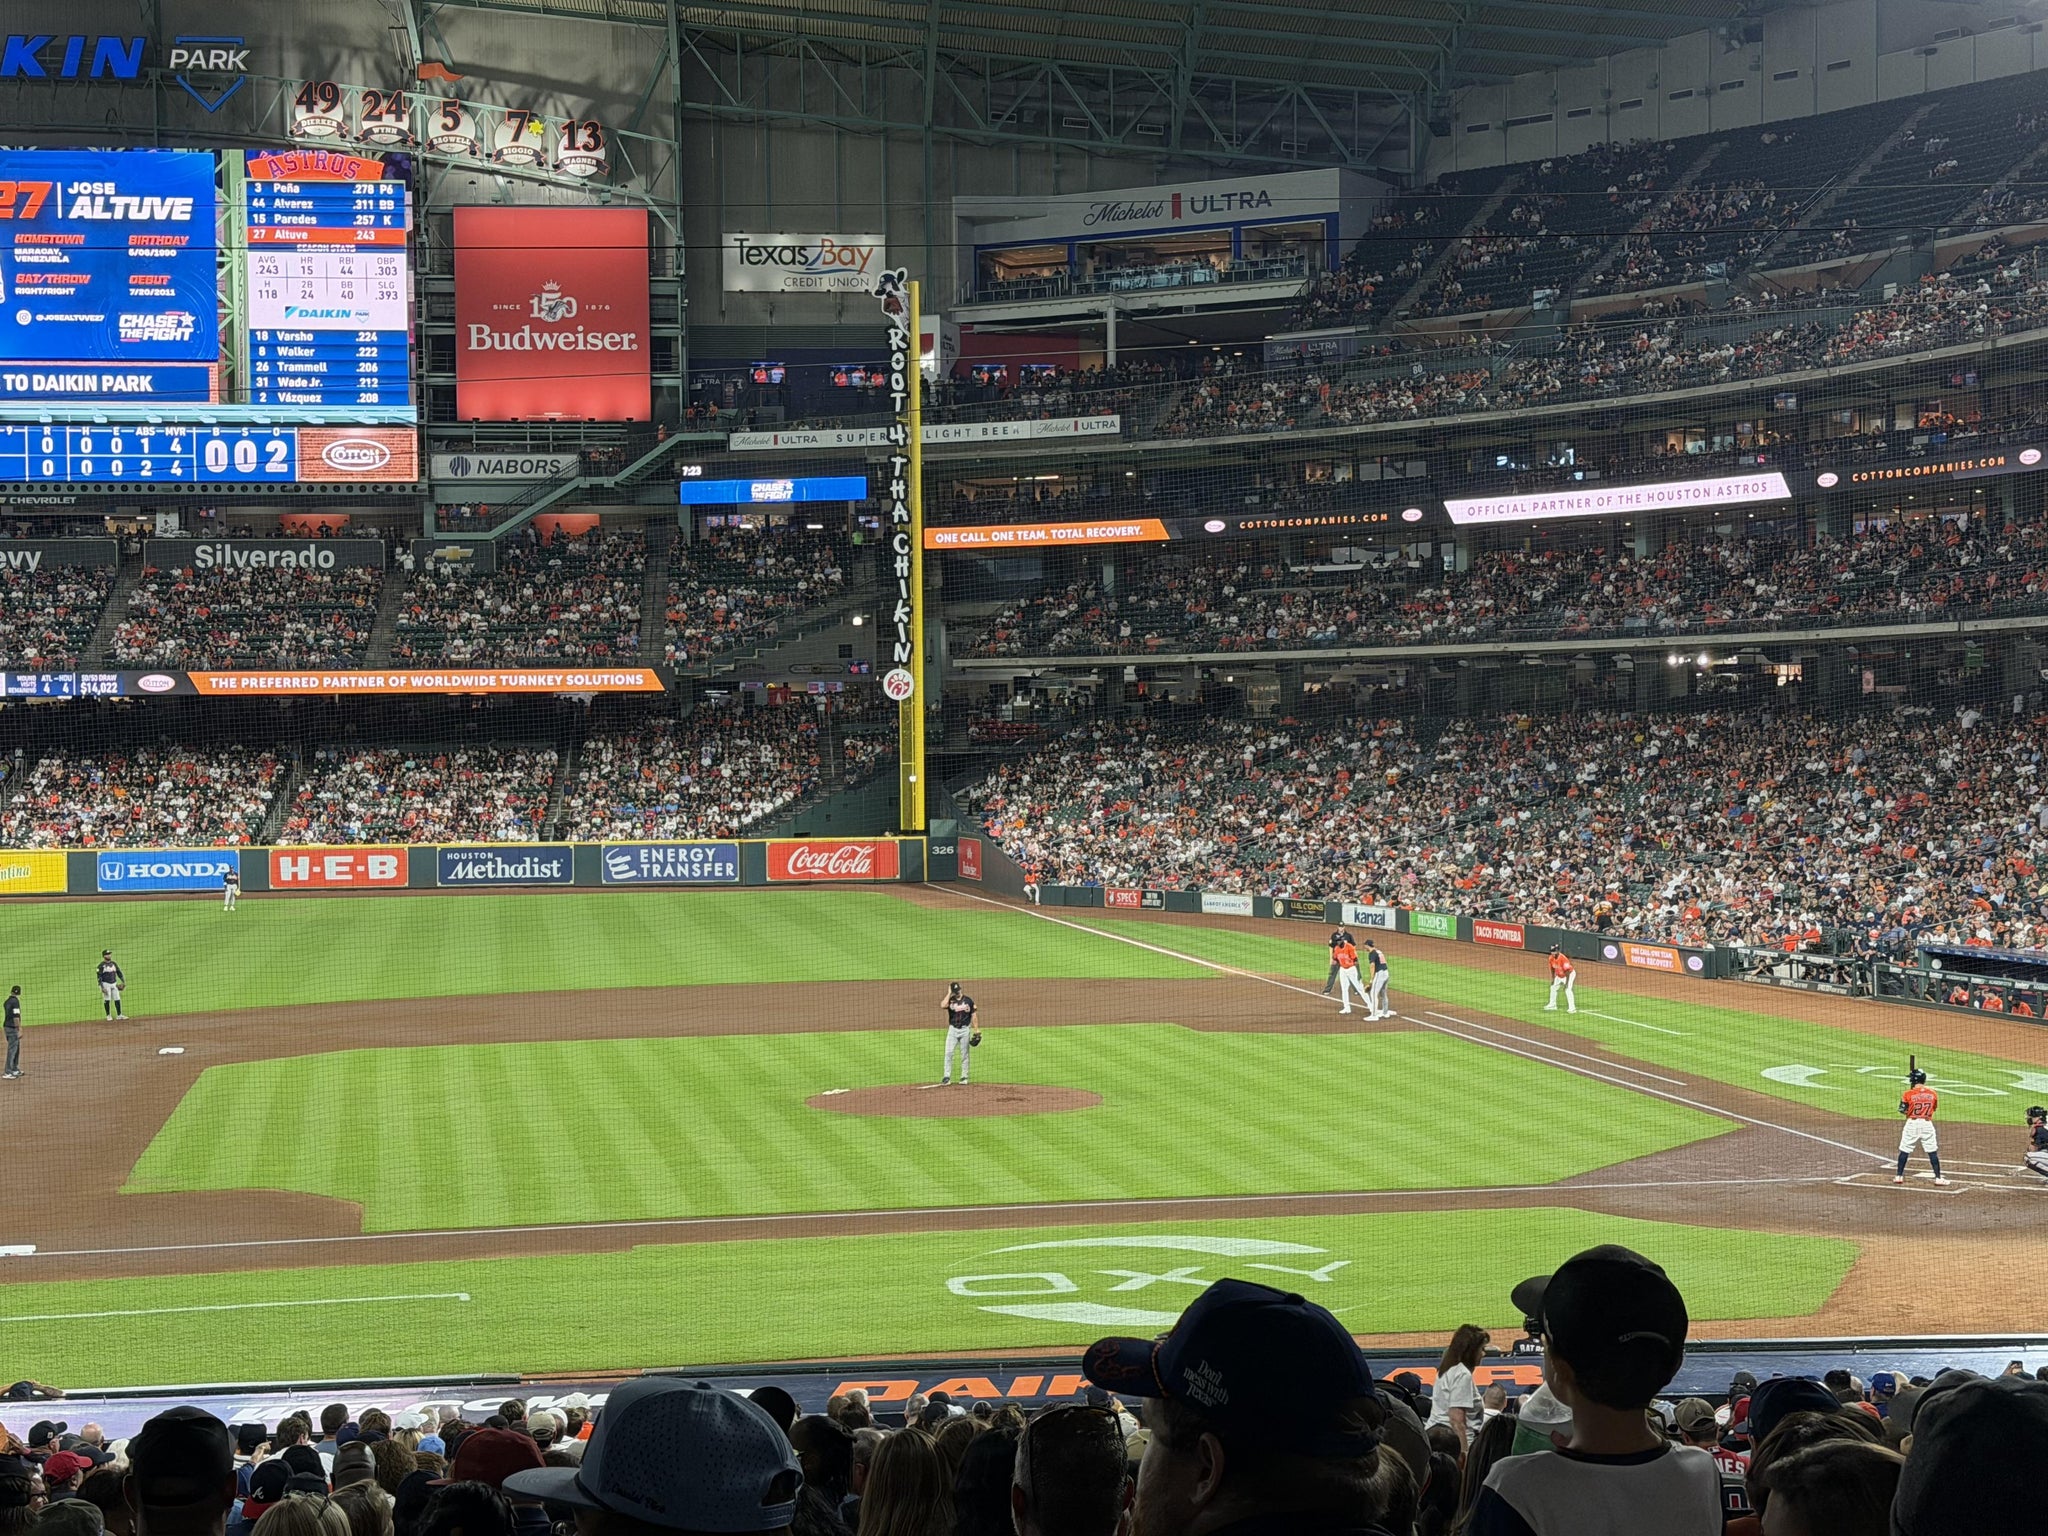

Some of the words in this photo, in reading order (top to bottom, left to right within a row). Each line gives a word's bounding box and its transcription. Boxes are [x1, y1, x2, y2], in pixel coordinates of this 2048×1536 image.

[1, 35, 146, 79] KIN
[169, 48, 251, 72] PARK
[295, 81, 342, 114] 49
[361, 90, 407, 123] 24
[441, 99, 462, 132] 5
[301, 118, 338, 128] DIERKER
[506, 110, 530, 143] 7
[372, 127, 398, 135] WYNN
[561, 119, 604, 152] 13
[432, 135, 472, 146] BAGWELL
[502, 147, 534, 156] BIGGIO
[267, 150, 361, 181] ASTROS
[563, 157, 597, 166] WAGNER
[67, 181, 115, 195] JOSE
[254, 184, 262, 193] 3
[273, 183, 300, 194] Peña
[352, 184, 374, 195] .278
[379, 185, 394, 195] P6
[68, 196, 194, 220] ALTUVE
[252, 199, 265, 208] 44
[273, 199, 314, 209] Alvarez
[352, 200, 374, 210] .311
[379, 200, 395, 210] BB
[1083, 199, 1165, 227] Michelob
[1190, 189, 1273, 215] ULTRA
[252, 214, 266, 224] 15
[274, 213, 317, 225] Paredes
[353, 215, 375, 226] .257
[383, 215, 392, 226] K
[14, 233, 85, 245] HOMETOWN
[128, 235, 189, 246] BIRTHDAY
[253, 230, 266, 240] 27
[274, 229, 308, 240] Altuve
[353, 230, 376, 241] .243
[14, 255, 70, 264] VENEZUELA
[258, 256, 276, 264] AVG
[339, 257, 354, 265] RBI
[377, 257, 395, 265] OBP
[734, 237, 809, 267] Texas
[820, 238, 873, 275] Bay
[255, 265, 279, 275] .243
[301, 266, 314, 275] 15
[340, 266, 354, 276] 44
[374, 266, 398, 276] .303
[15, 274, 91, 285] BAT/THROW
[129, 275, 171, 285] DEBUT
[341, 281, 353, 289] BB
[378, 281, 395, 290] SLG
[783, 277, 823, 288] CREDIT
[828, 277, 870, 288] UNION
[15, 287, 75, 296] RIGHT/RIGHT
[129, 288, 176, 297] 7/20/2011
[258, 289, 278, 299] 118
[301, 290, 314, 300] 24
[340, 290, 354, 300] 40
[375, 291, 399, 301] .393
[298, 309, 351, 319] DAIKIN
[530, 292, 577, 323] 150
[119, 314, 179, 328] CHASE
[119, 328, 144, 339] THE
[143, 328, 194, 341] FIGHT
[256, 331, 269, 341] 18
[277, 331, 314, 341] Varsho
[355, 332, 378, 342] .224
[258, 346, 266, 357] 8
[277, 346, 316, 357] Walker
[356, 347, 378, 357] .222
[256, 362, 269, 372] 26
[277, 362, 328, 372] Trammell
[356, 362, 378, 373] .206
[887, 328, 908, 413] ROOT
[3, 374, 29, 391] TO
[32, 374, 98, 392] DAIKIN
[102, 375, 153, 392] PARK
[256, 377, 269, 387] 31
[277, 377, 308, 388] Wade
[309, 377, 323, 388] Jr.
[356, 378, 379, 388] .212
[259, 392, 267, 403] 2
[277, 392, 322, 405] Vázquez
[356, 393, 379, 403] .208
[212, 427, 220, 436] B
[241, 427, 249, 436] S
[782, 435, 819, 444] ULTRA
[926, 427, 972, 438] LIGHT
[1081, 419, 1117, 431] ULTRA
[889, 423, 906, 446] 4
[477, 459, 562, 475] NABORS
[682, 466, 702, 476] 7:23
[1852, 456, 2005, 483] COTTONCOMPANIES.COM
[751, 482, 785, 492] CHASE
[889, 456, 909, 524] THA
[10, 496, 77, 505] CHEVROLET
[764, 491, 794, 500] FIGHT
[1467, 503, 1527, 517] OFFICIAL
[1532, 498, 1592, 512] PARTNER
[1597, 496, 1613, 507] OF
[1618, 493, 1642, 505] THE
[1646, 487, 1711, 503] HOUSTON
[1716, 481, 1768, 497] ASTROS
[1239, 513, 1388, 530] COTTONCOMPANIES.COM
[935, 533, 958, 543] ONE
[960, 532, 990, 543] CALL.
[991, 531, 1014, 542] ONE
[1016, 530, 1049, 541] TEAM.
[1050, 528, 1085, 539] TOTAL
[1086, 525, 1143, 538] RECOVERY.
[195, 543, 335, 569] Silverado
[893, 533, 912, 663] CHIKIN
[99, 674, 118, 682] DRAW
[209, 677, 237, 689] THE
[241, 676, 320, 689] PREFERRED
[323, 676, 385, 688] PARTNER
[389, 676, 407, 687] OF
[410, 675, 497, 687] WORLDWIDE
[500, 674, 563, 687] TURNKEY
[566, 674, 644, 686] SOLUTIONS
[80, 682, 118, 695] $14,022
[447, 852, 493, 861] HOUSTON
[640, 847, 716, 863] ENERGY
[931, 846, 954, 855] 326
[787, 845, 876, 875] Coca-Cola
[127, 862, 231, 878] HONDA
[280, 855, 398, 881] H-E-B
[448, 857, 561, 880] Methodist
[641, 862, 735, 878] TRANSFER
[1354, 906, 1386, 927] kanzai
[1475, 925, 1492, 938] TACOS
[1914, 1102, 1931, 1116] 27
[946, 1260, 1352, 1296] OXY
